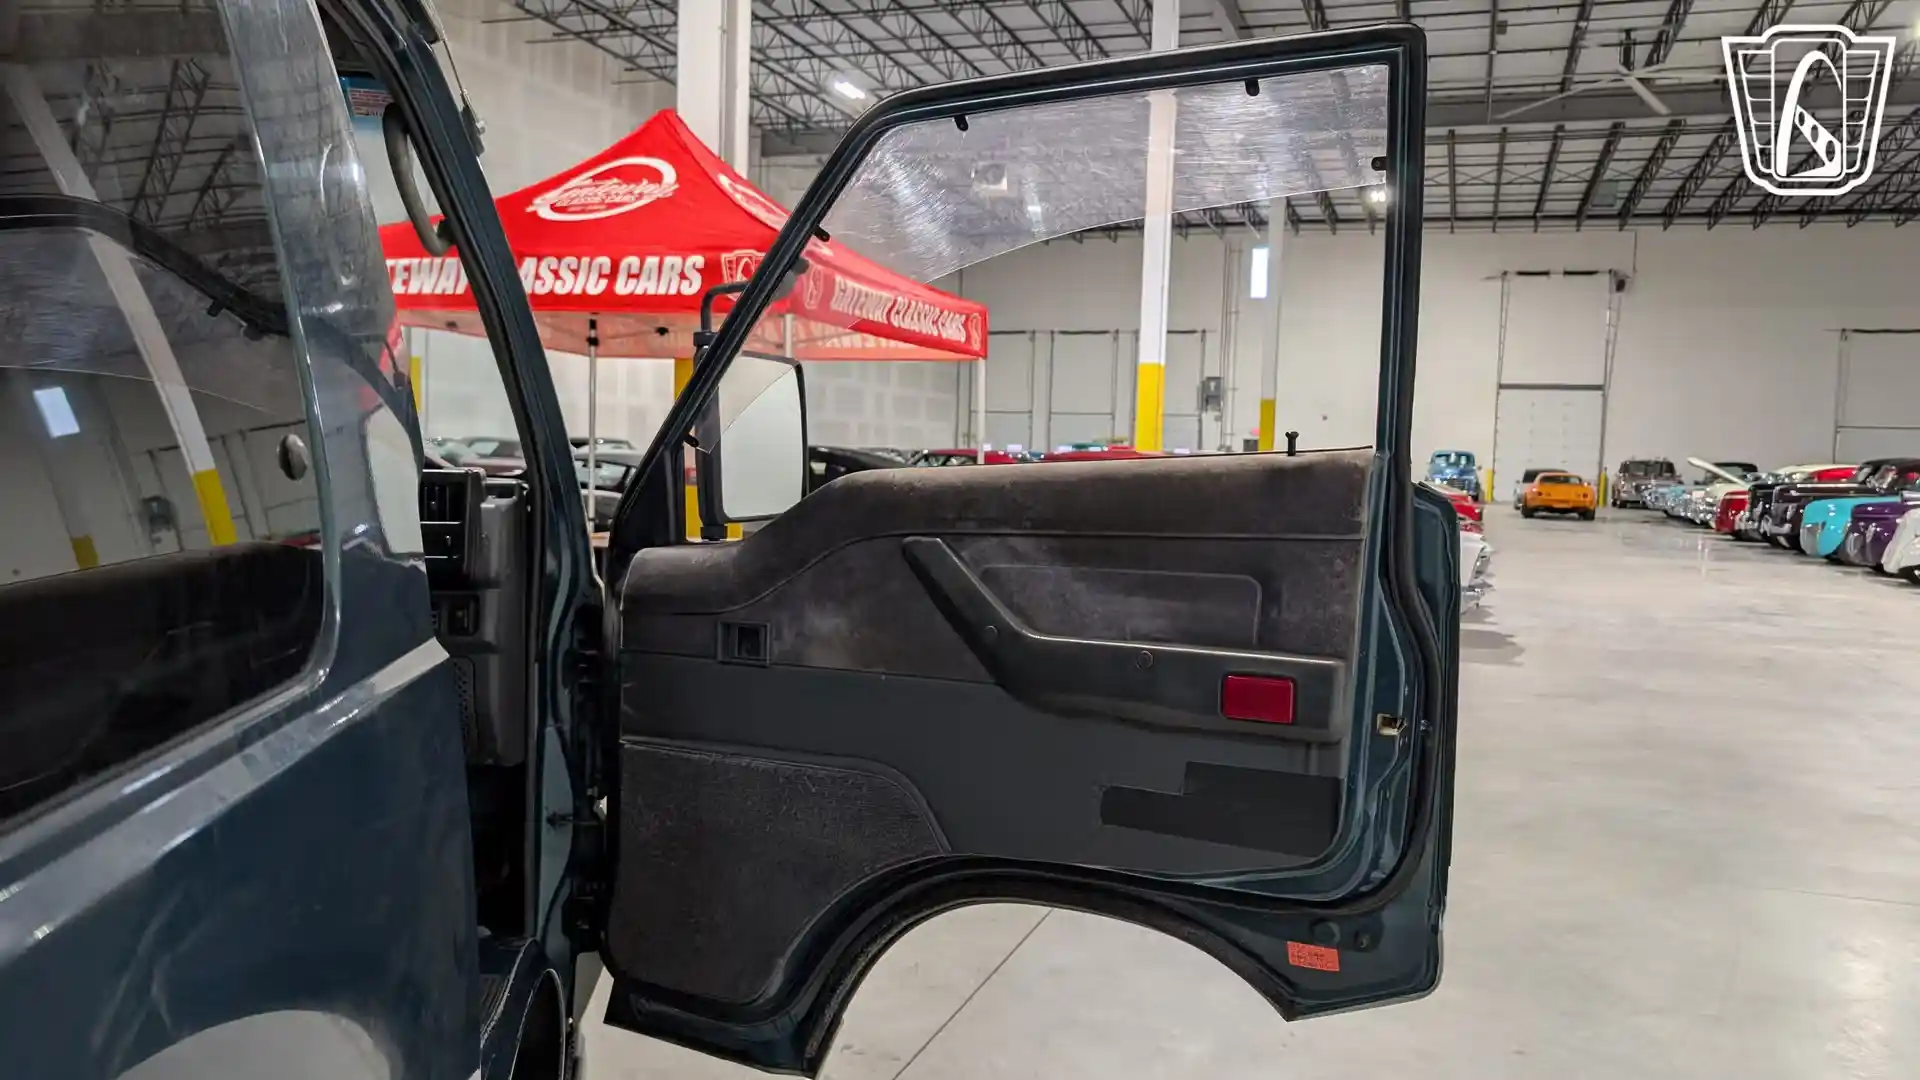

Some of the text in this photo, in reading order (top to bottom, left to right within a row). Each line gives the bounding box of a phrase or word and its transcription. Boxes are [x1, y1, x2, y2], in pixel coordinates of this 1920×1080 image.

[385, 255, 705, 296] EWAY ASSIC CARS
[829, 274, 967, 344] GATEWAY CLASSIC CARS
